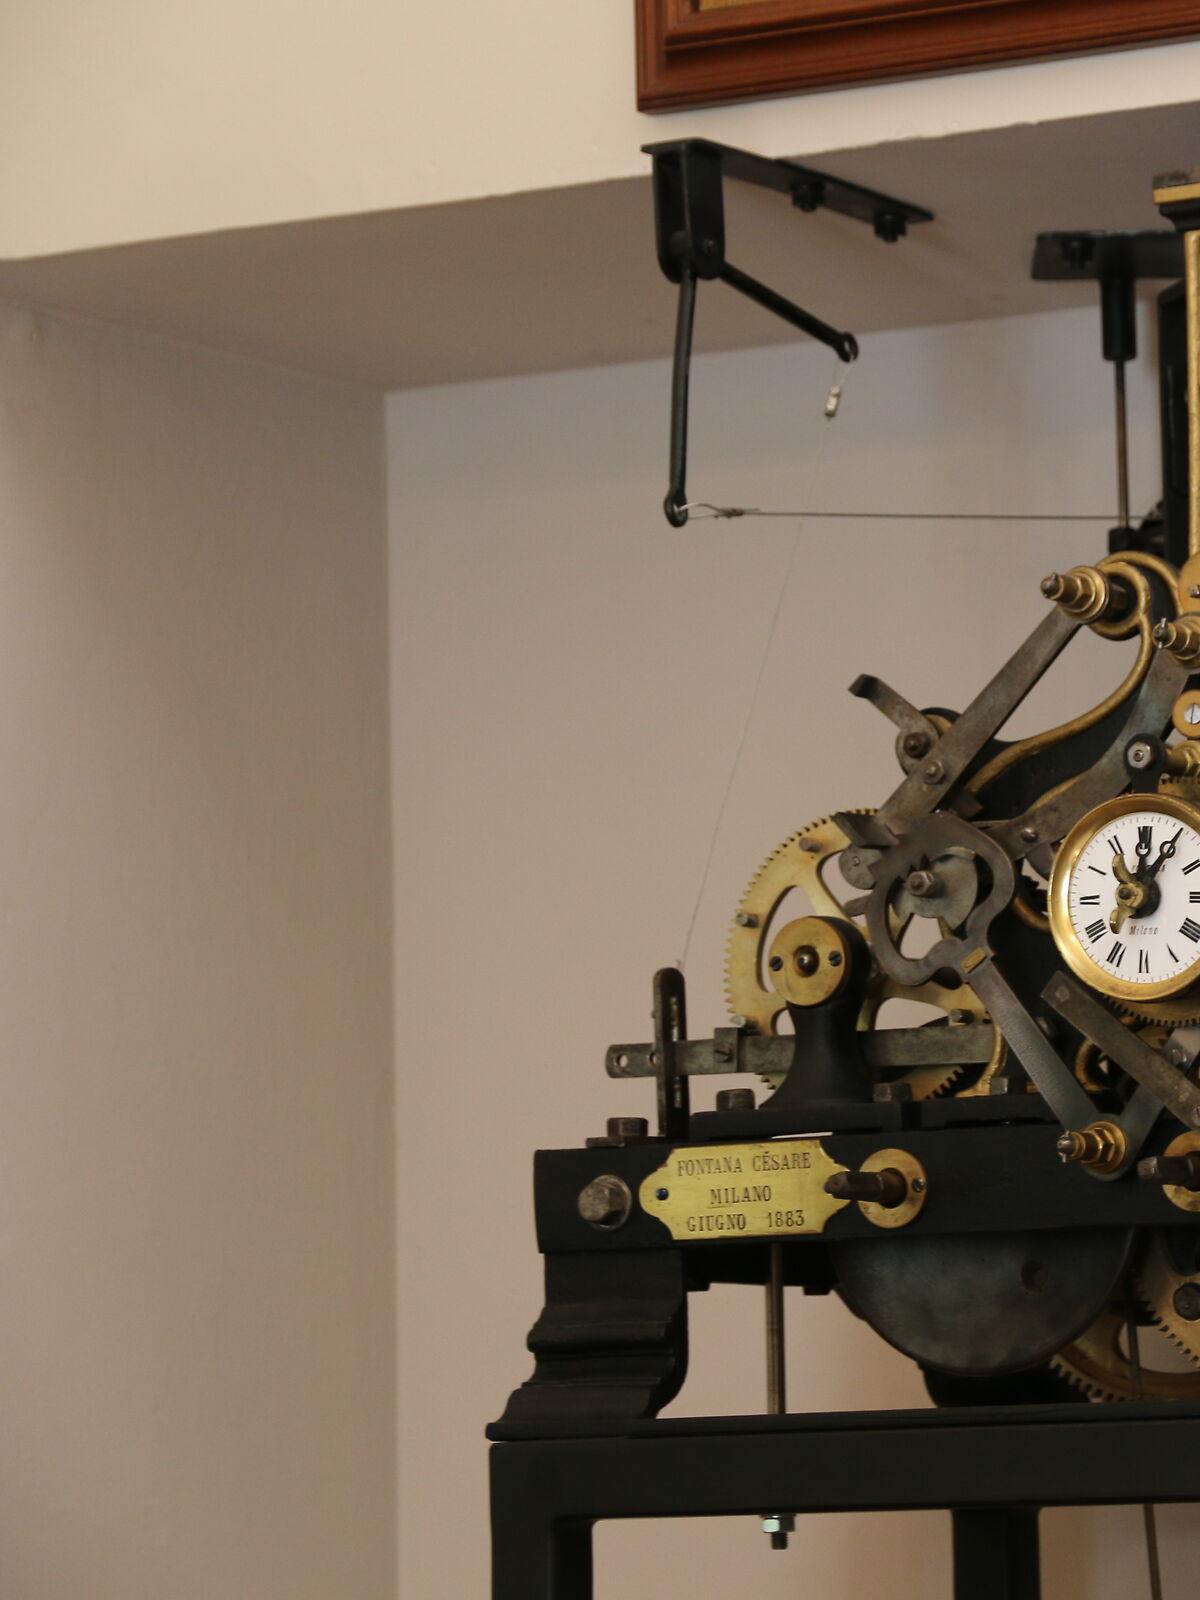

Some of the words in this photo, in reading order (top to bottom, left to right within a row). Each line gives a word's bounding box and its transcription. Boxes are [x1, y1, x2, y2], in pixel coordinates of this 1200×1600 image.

[677, 1156, 742, 1177] FONTANA
[752, 1151, 811, 1172] CÉSARE
[710, 1185, 773, 1204] MILANO
[687, 1213, 748, 1232] GIUGNO
[767, 1209, 805, 1228] 1883
